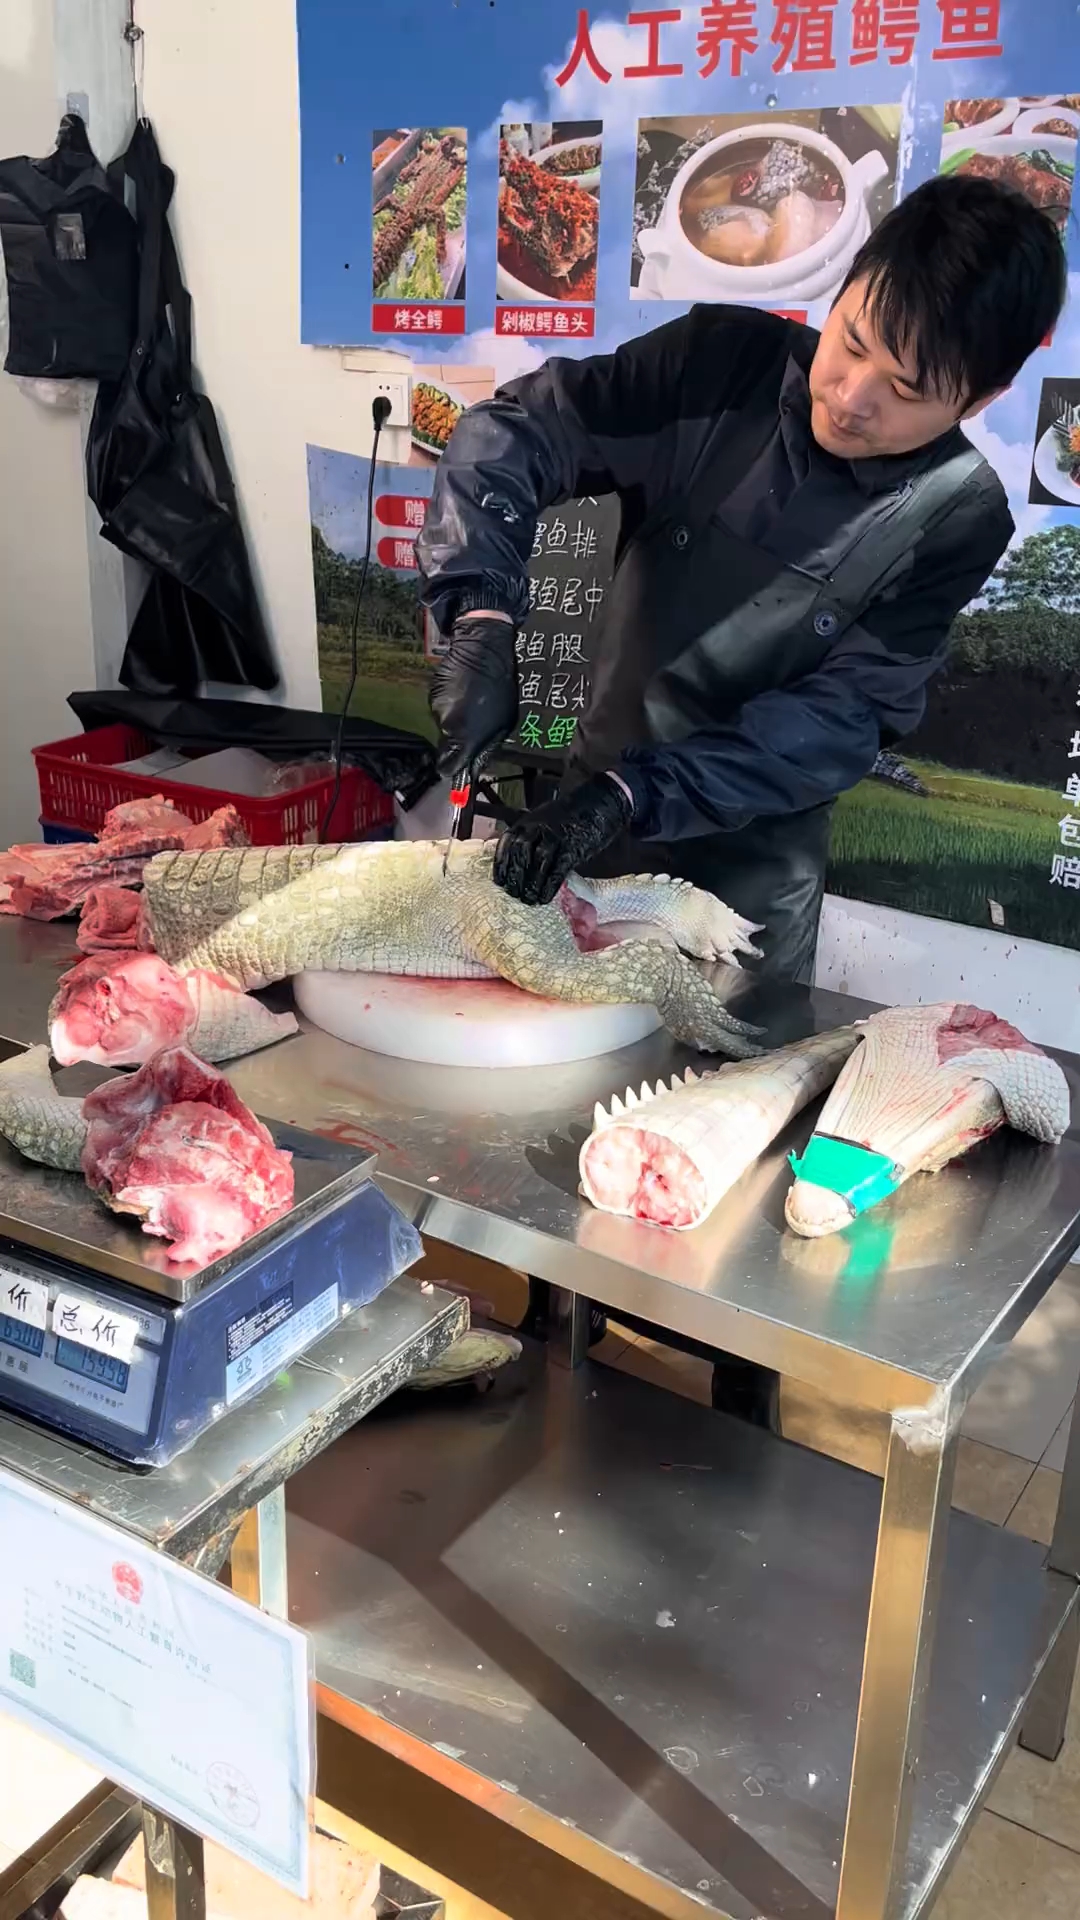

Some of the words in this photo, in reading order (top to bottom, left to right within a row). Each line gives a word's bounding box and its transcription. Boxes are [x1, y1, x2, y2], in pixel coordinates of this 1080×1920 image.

[554, 0, 1004, 88] 人工养殖鳄鱼
[394, 309, 443, 330] 烤全鳄
[501, 311, 588, 333] 剁椒鳄鱼头
[404, 499, 426, 527] 赠
[518, 671, 589, 711] 鱼尾尖
[60, 1304, 120, 1348] 总价
